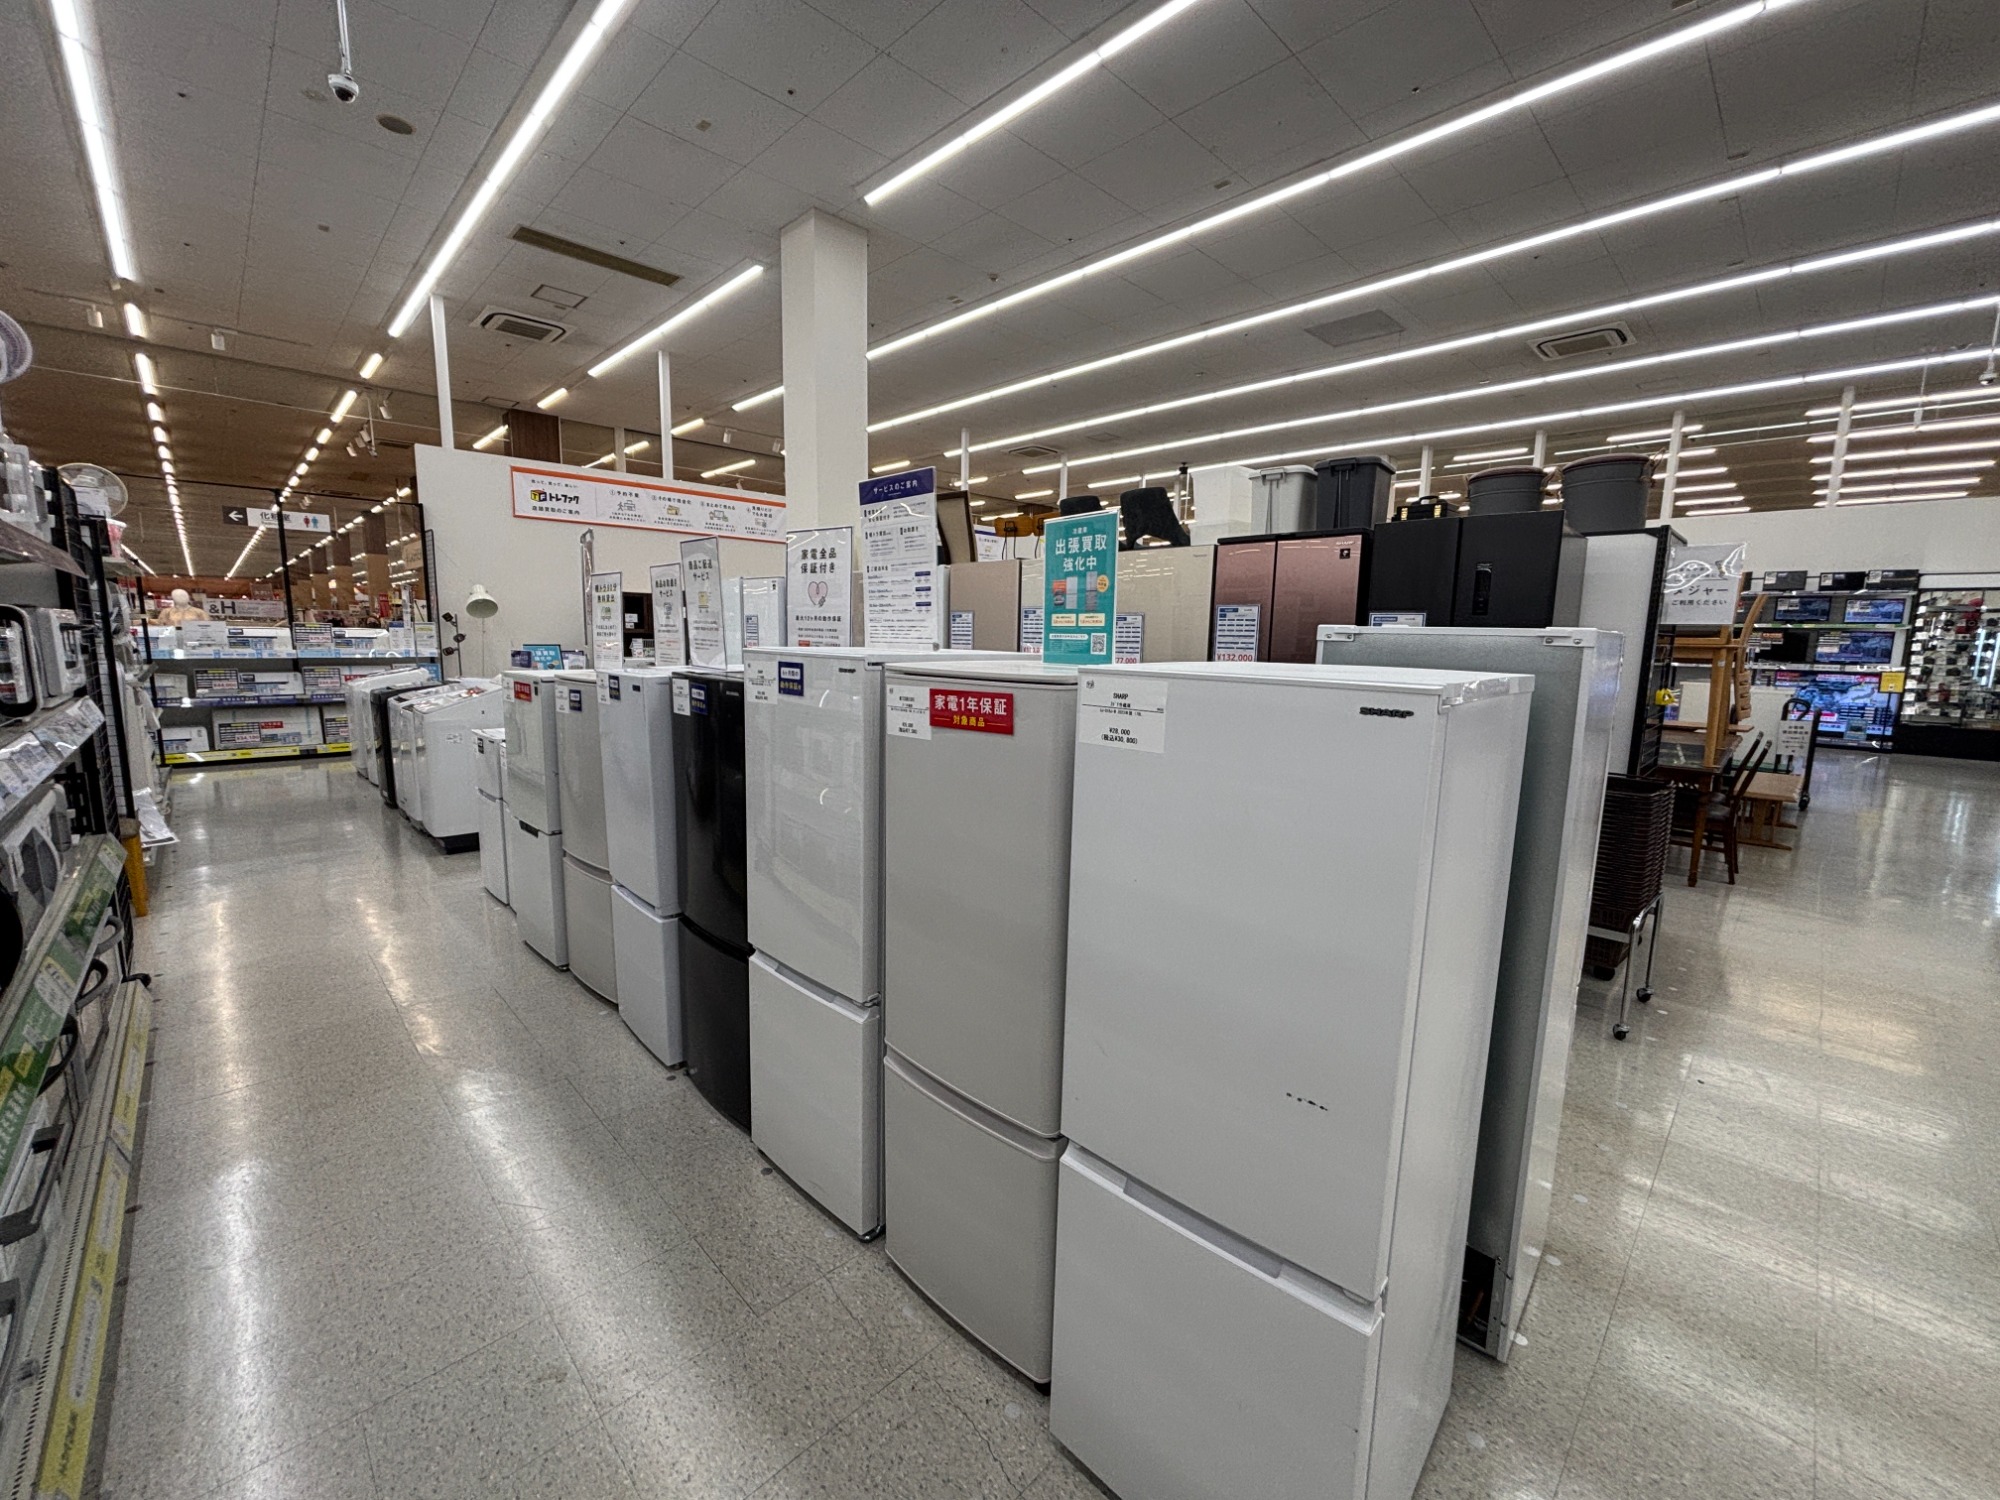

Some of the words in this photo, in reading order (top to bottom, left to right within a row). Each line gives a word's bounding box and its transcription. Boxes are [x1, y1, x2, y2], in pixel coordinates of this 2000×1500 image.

[873, 480, 918, 495] サービスのご案内
[549, 493, 580, 504] トレファク
[1055, 534, 1107, 556] 出張買取
[801, 547, 837, 560] 家電全品
[800, 562, 836, 574] 保証付き
[1063, 555, 1097, 573] 強化中
[1217, 653, 1253, 662] ¥132,000
[1113, 692, 1129, 700] SHARP
[934, 694, 1008, 716] 家電1年保証
[1359, 706, 1415, 719] SHARP
[952, 714, 985, 727] 対象商品
[1109, 727, 1131, 736] ¥28,000
